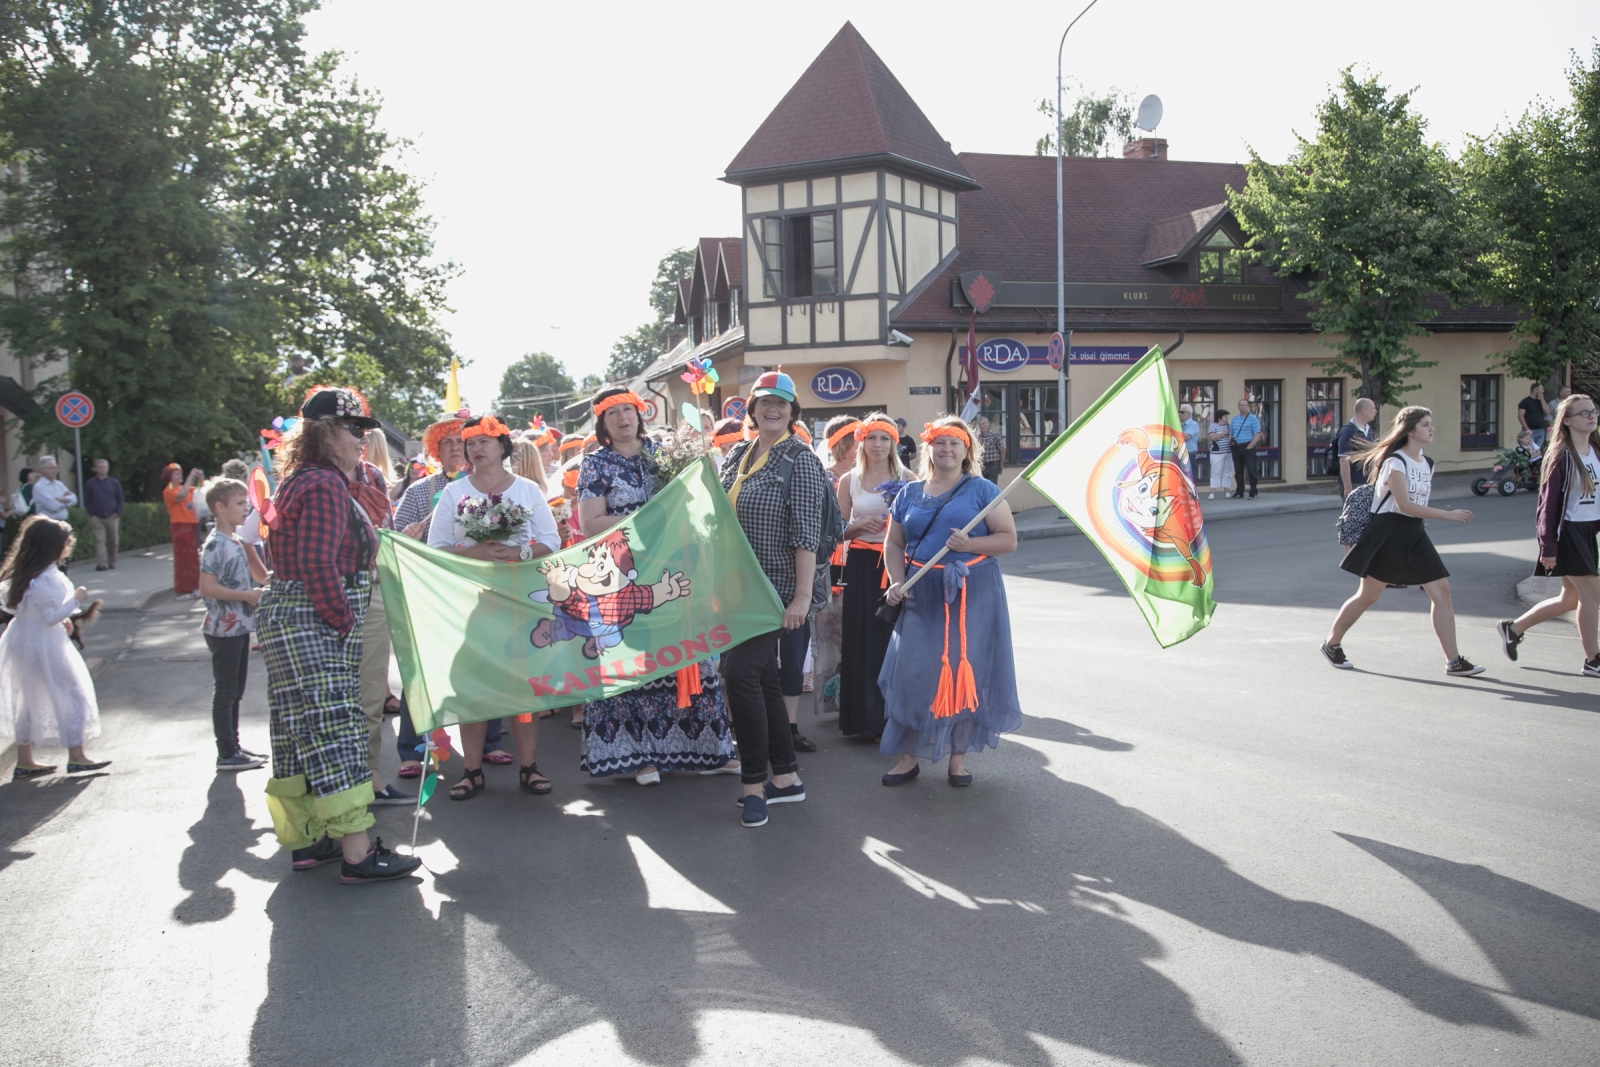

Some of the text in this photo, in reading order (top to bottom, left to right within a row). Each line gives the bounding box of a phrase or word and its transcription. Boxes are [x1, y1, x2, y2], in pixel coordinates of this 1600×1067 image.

[1123, 292, 1148, 300] KLUBS
[1232, 293, 1256, 301] KLUBS
[1080, 351, 1096, 360] visai
[527, 624, 732, 697] KARLSONS
